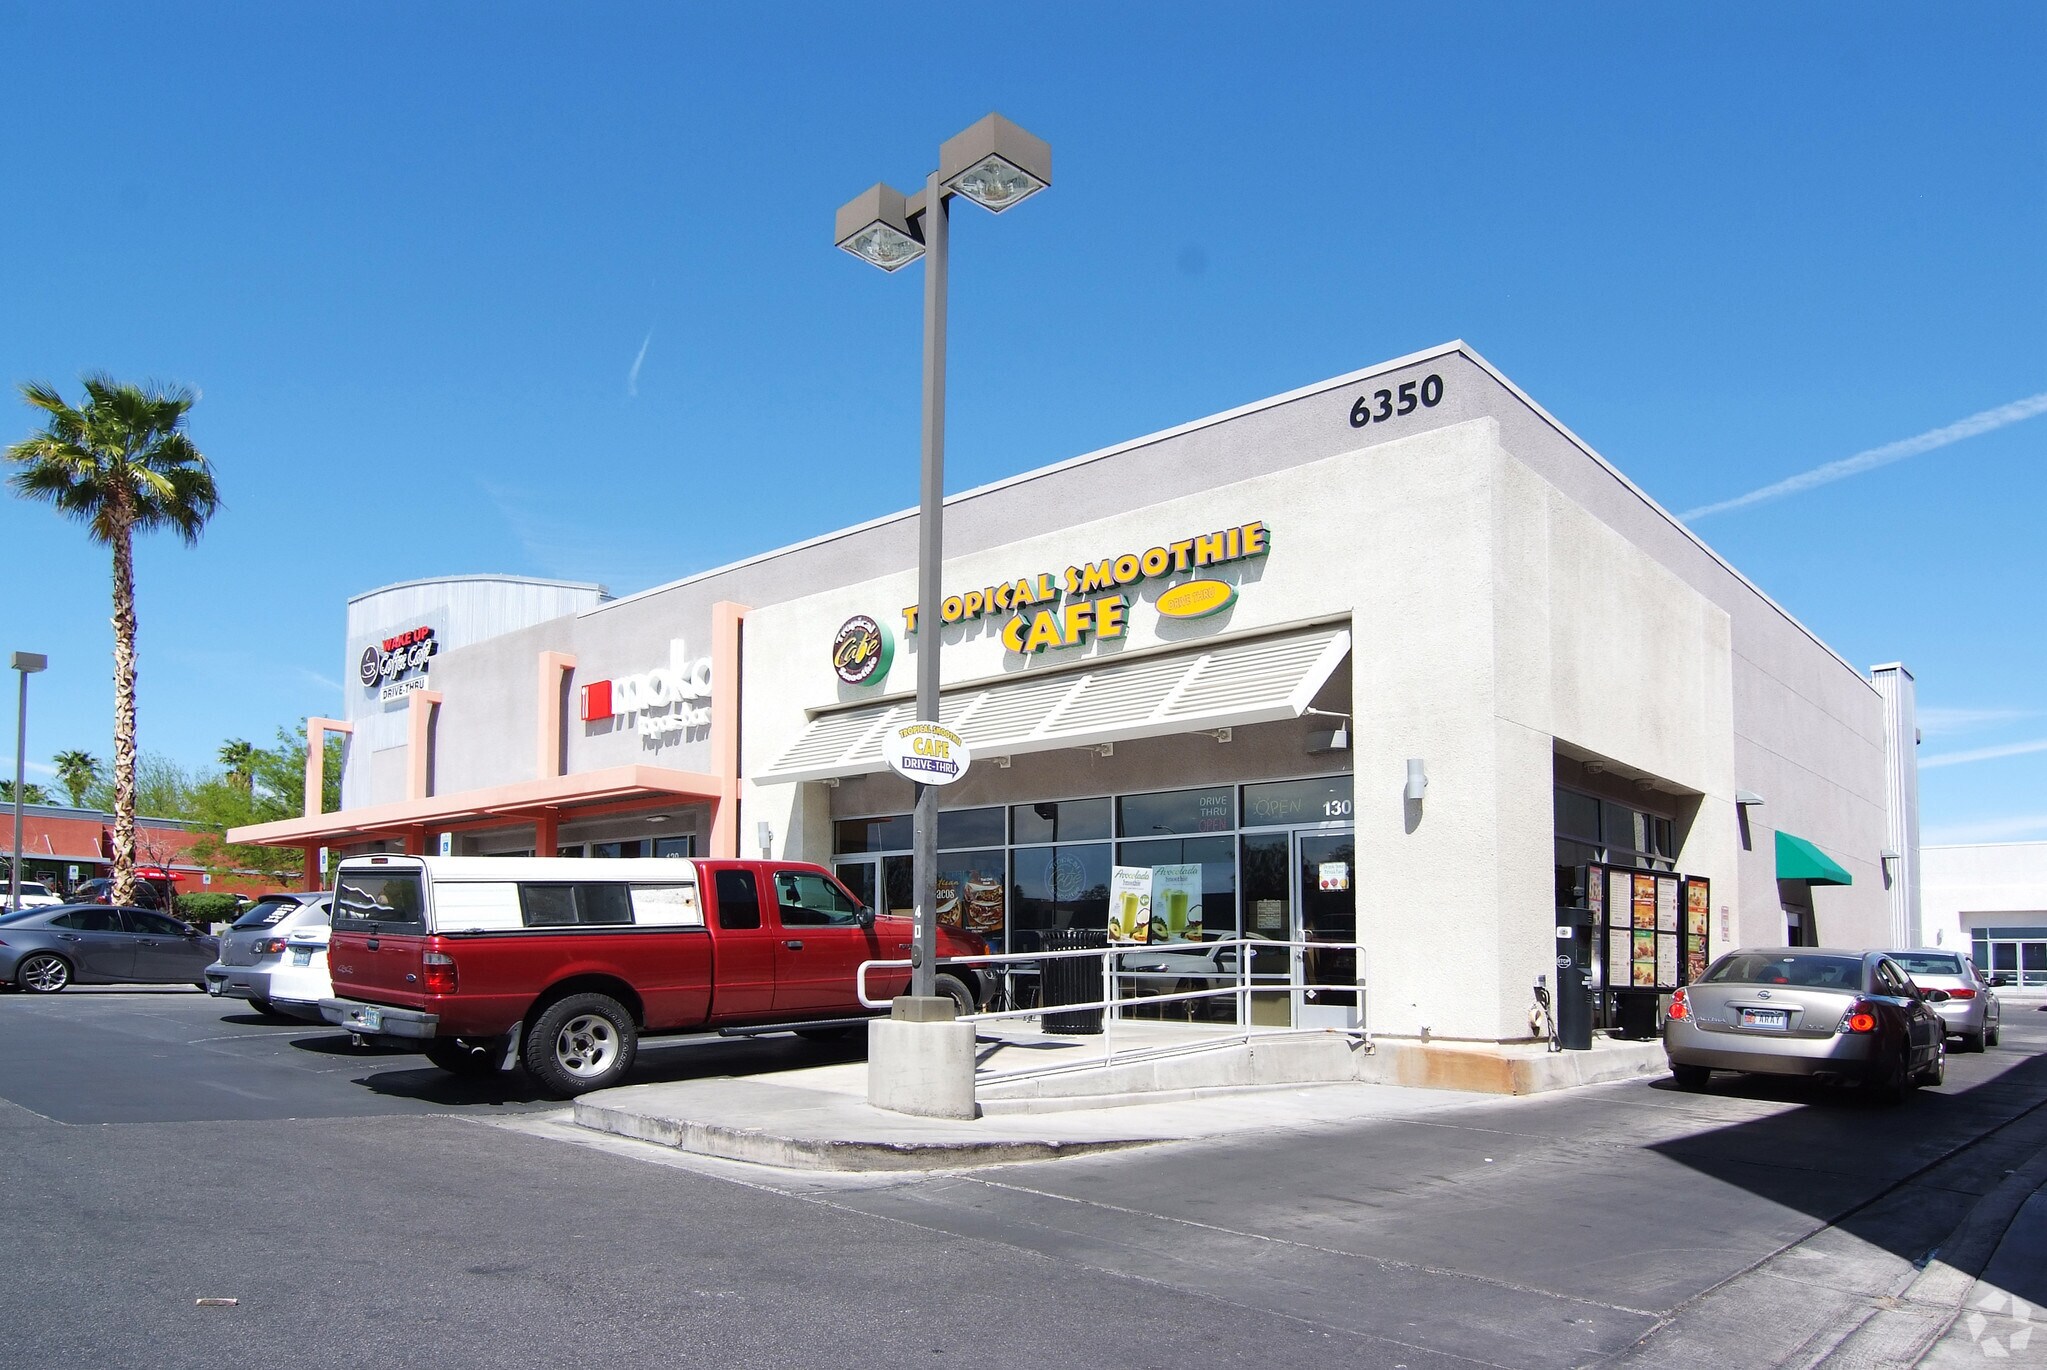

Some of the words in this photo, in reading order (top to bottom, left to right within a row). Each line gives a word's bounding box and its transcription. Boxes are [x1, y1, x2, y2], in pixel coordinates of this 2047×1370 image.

[1350, 374, 1444, 428] 6350
[903, 573, 1056, 632] TOPICAL
[1065, 521, 1264, 594] SMOOTHIE
[1168, 593, 1192, 610] DRIVE
[1193, 586, 1217, 603] THRU
[835, 616, 877, 644] Tropical
[1002, 595, 1125, 653] CAFE
[382, 630, 412, 652] WAKE
[413, 625, 429, 642] UP
[380, 647, 407, 680] Coffee
[839, 656, 878, 681] Smoothie
[611, 638, 712, 714] moko
[383, 677, 425, 699] DRIVE-THRU
[899, 724, 932, 739] TROPICAL
[932, 724, 962, 747] SMOOTHIE
[913, 737, 950, 759] CAFE
[904, 757, 957, 774] DRIVE-THRU
[1200, 796, 1227, 806] DRIVE
[1201, 807, 1227, 817] THRU
[1255, 798, 1302, 816] OPEN
[1322, 799, 1352, 816] 130
[1199, 818, 1227, 832] OPEN
[936, 888, 955, 899] acos
[914, 904, 922, 918] 4
